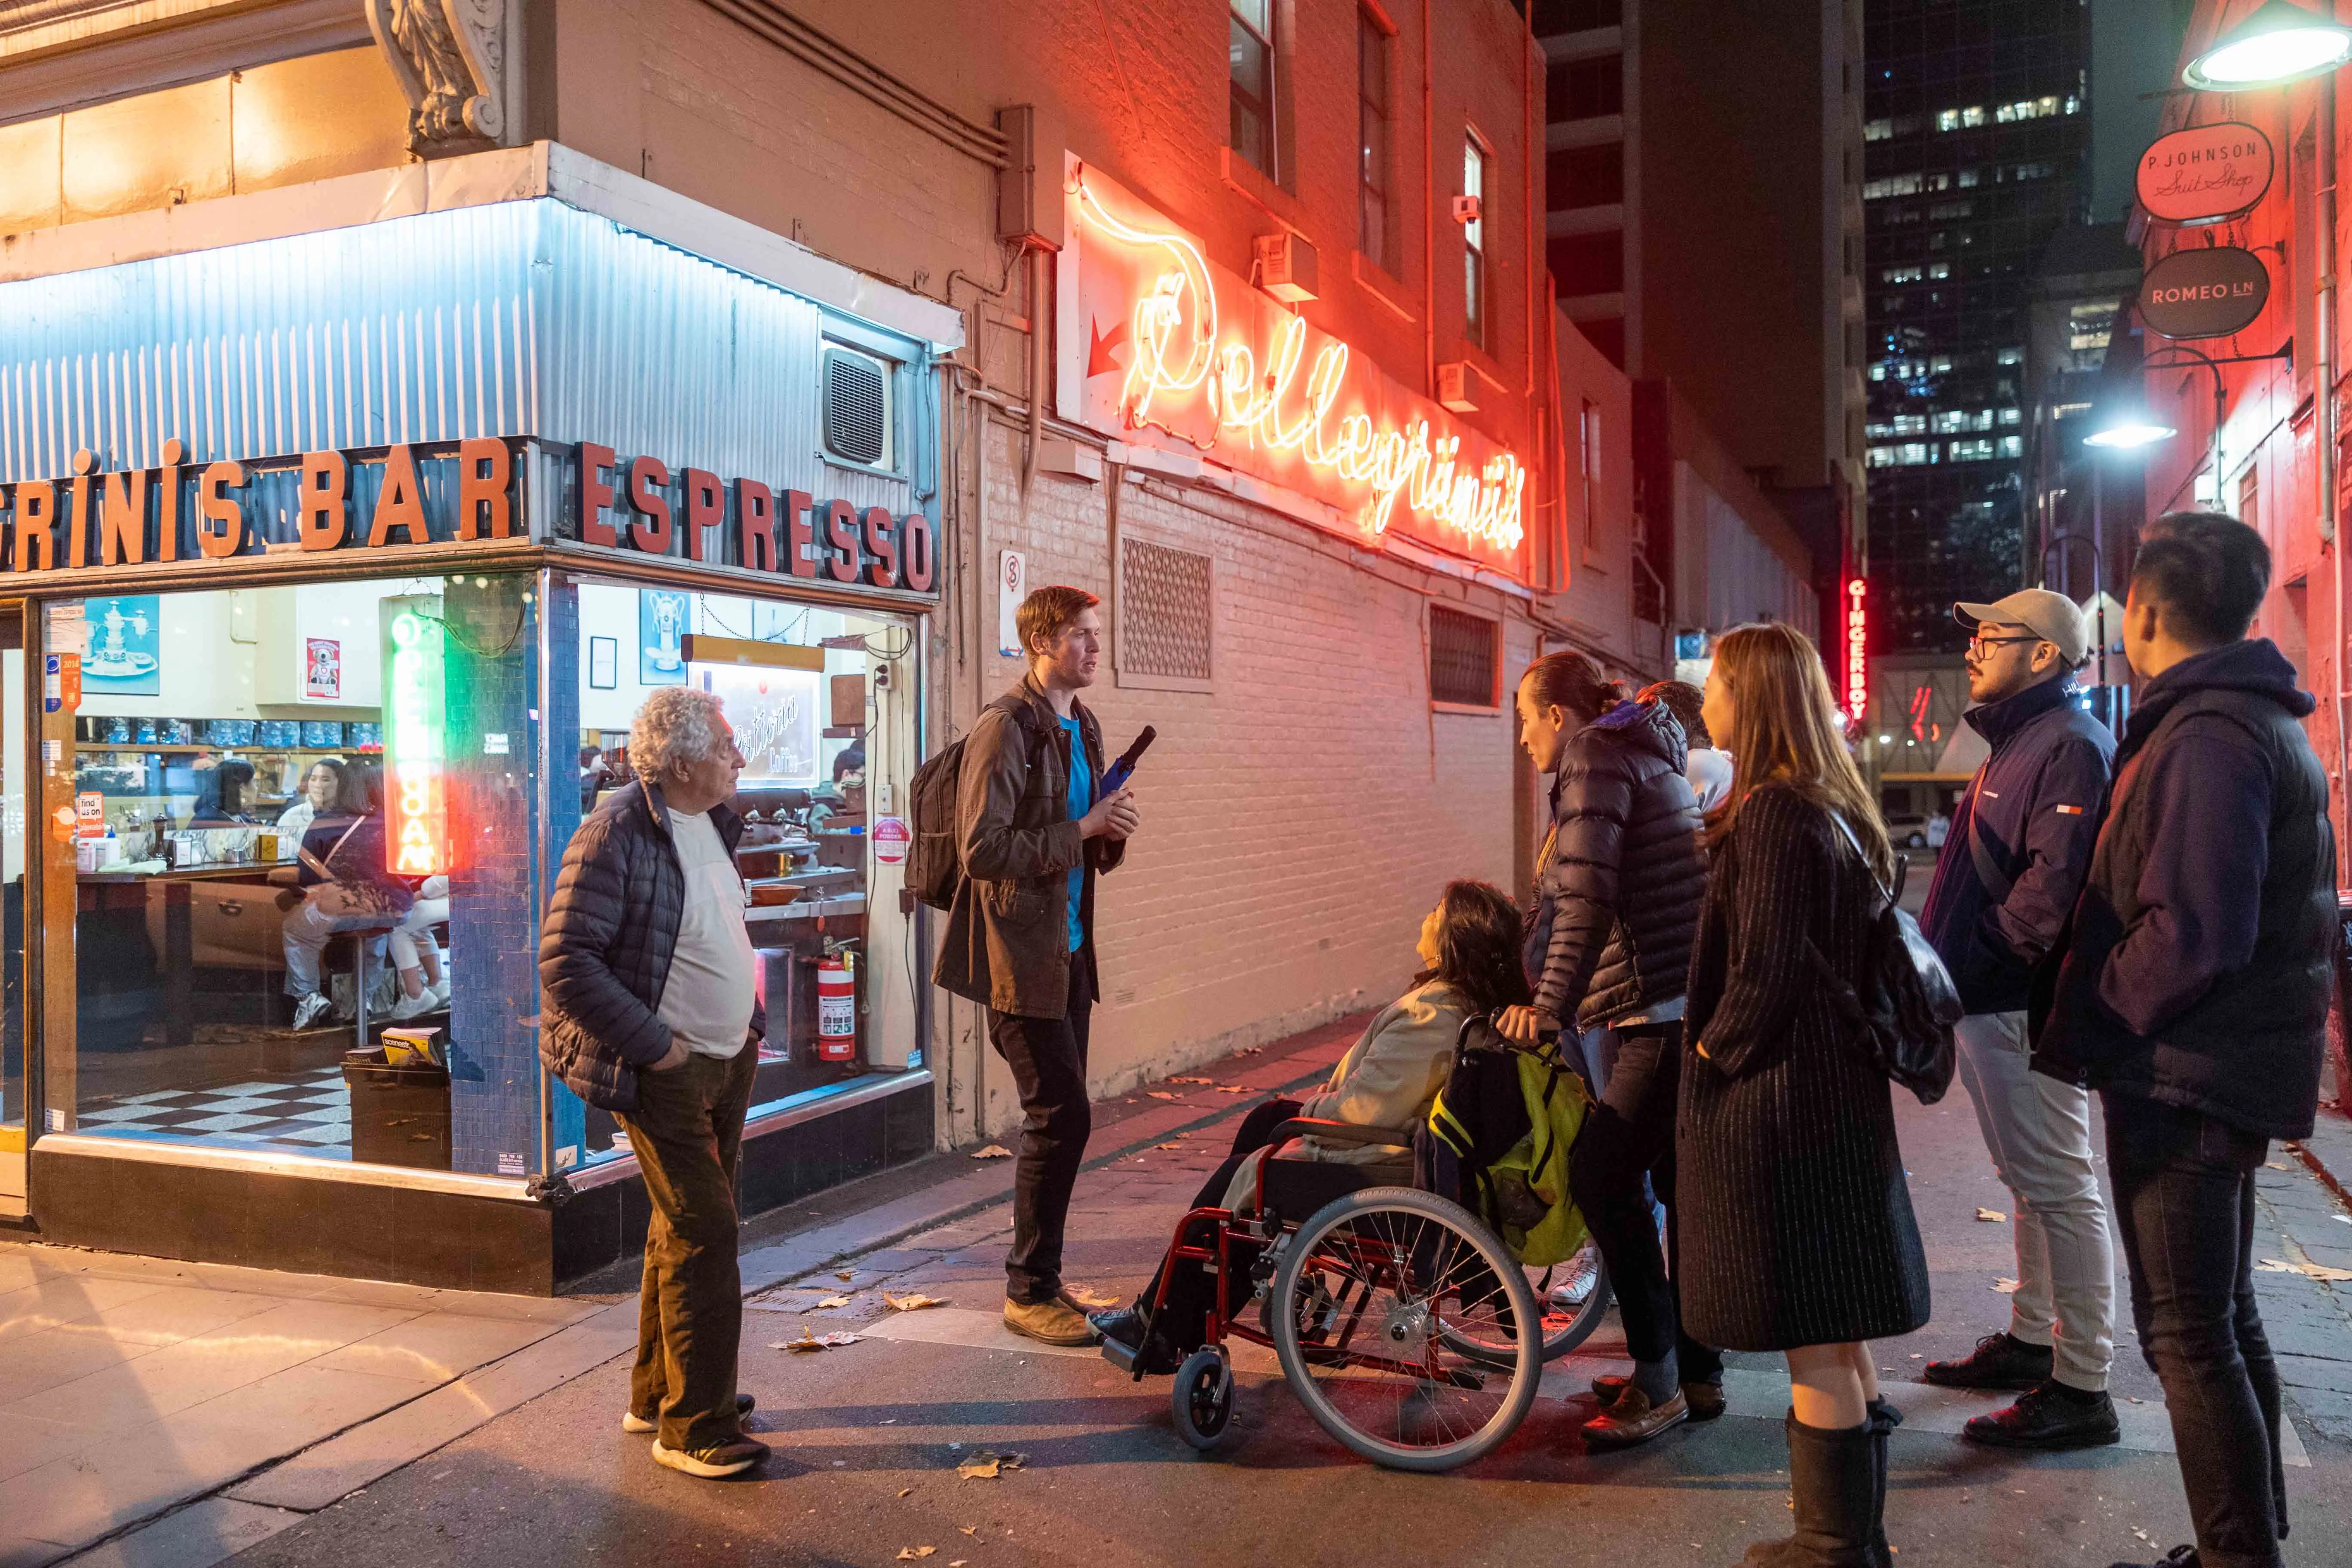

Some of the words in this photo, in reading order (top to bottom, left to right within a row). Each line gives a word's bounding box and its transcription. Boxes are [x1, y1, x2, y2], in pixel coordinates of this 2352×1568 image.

[2164, 142, 2257, 168] JOHNSON
[2205, 163, 2253, 196] Shop
[2153, 284, 2226, 303] ROMEO
[2233, 281, 2253, 295] LN
[301, 436, 515, 552] BAR
[574, 441, 933, 591] ESPRESSO
[1848, 579, 1867, 720] GINGERBOY
[768, 746, 798, 773] Coffee
[81, 798, 95, 807] find
[384, 1038, 410, 1048] scenestr
